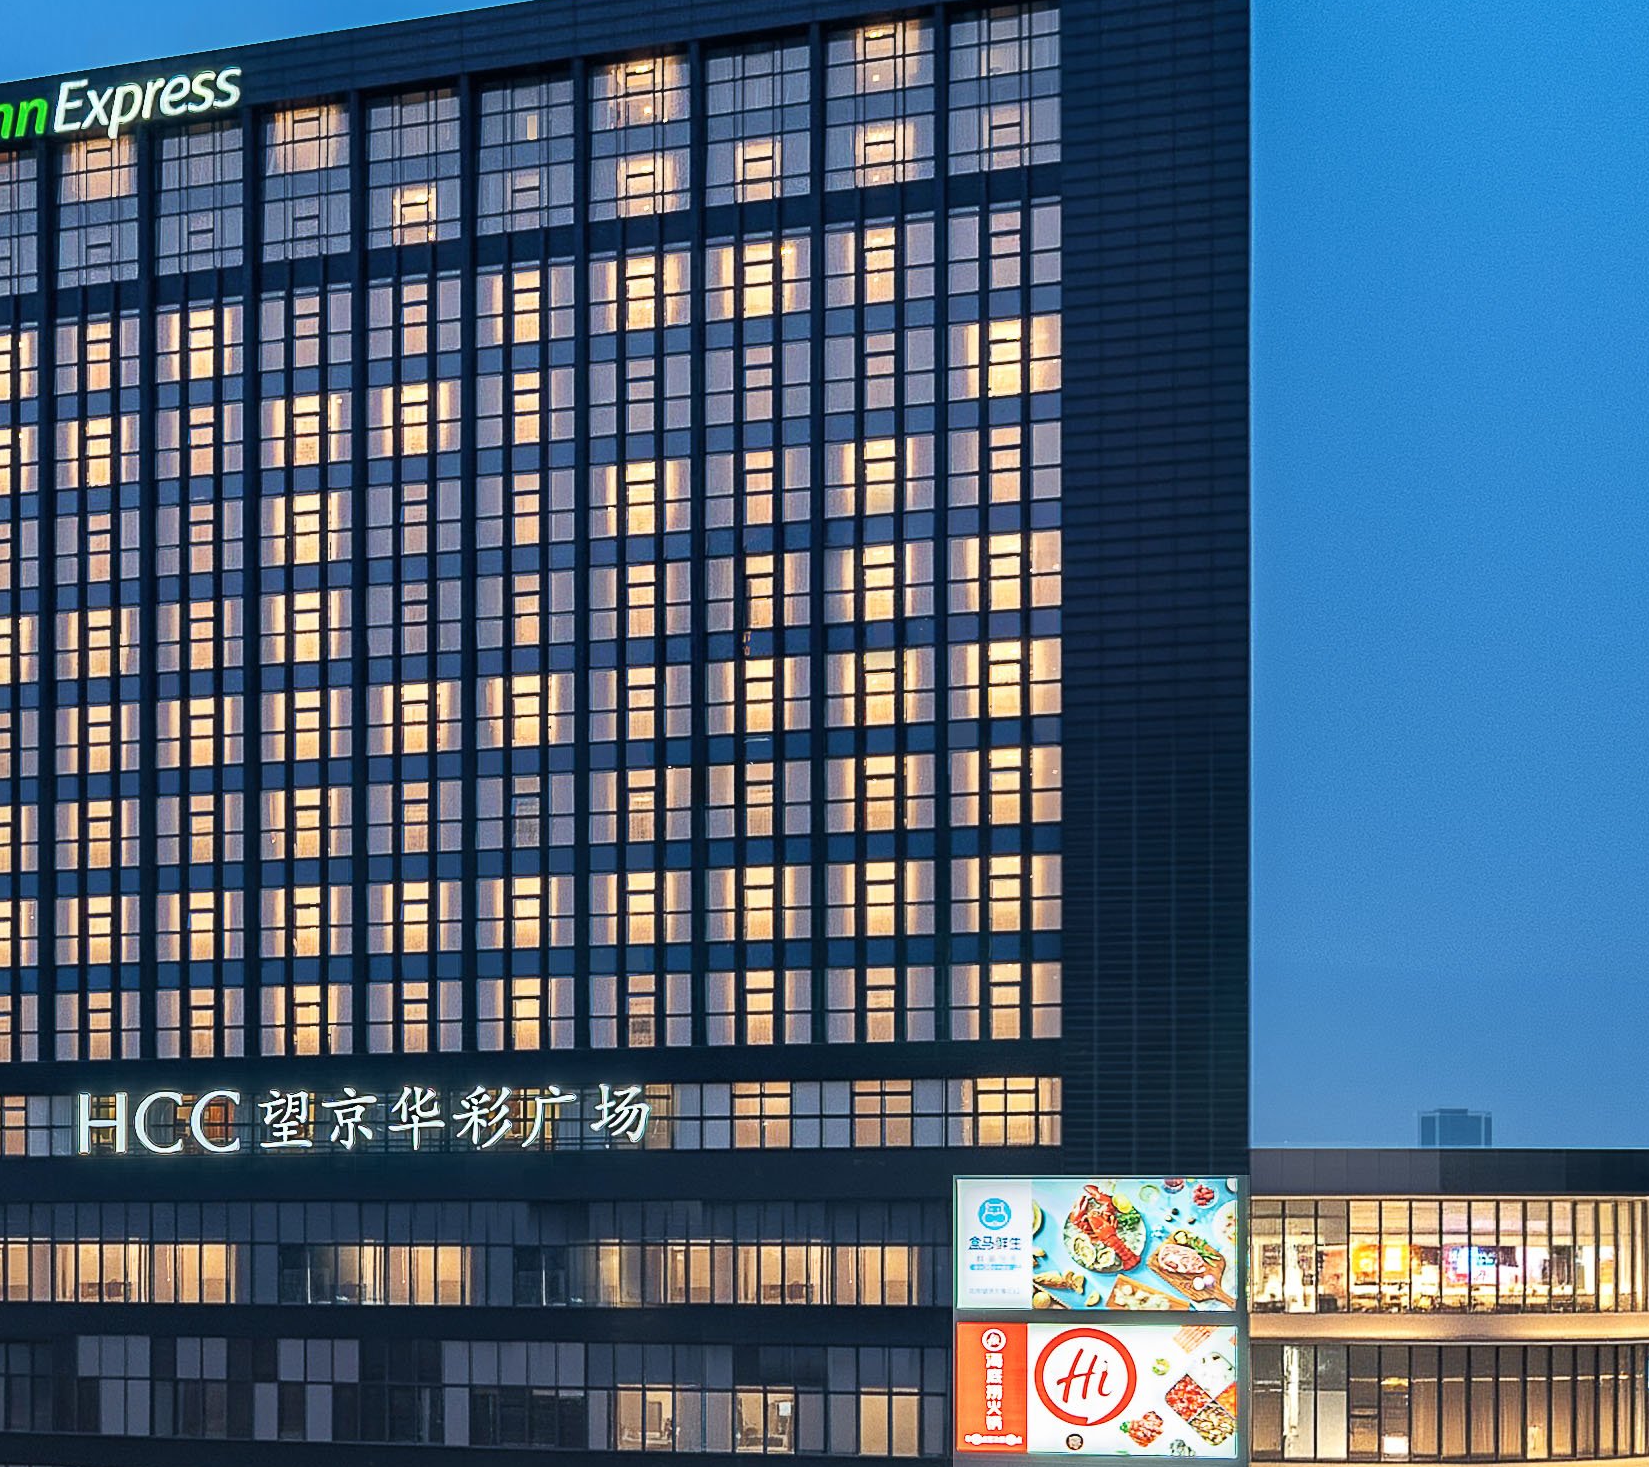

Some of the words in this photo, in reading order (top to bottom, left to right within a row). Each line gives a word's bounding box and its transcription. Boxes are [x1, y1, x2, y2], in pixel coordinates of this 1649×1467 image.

[52, 65, 243, 140] Express
[77, 1090, 242, 1155] HCC
[257, 1084, 651, 1151] 望京华彩广场
[1056, 1347, 1113, 1404] Hi
